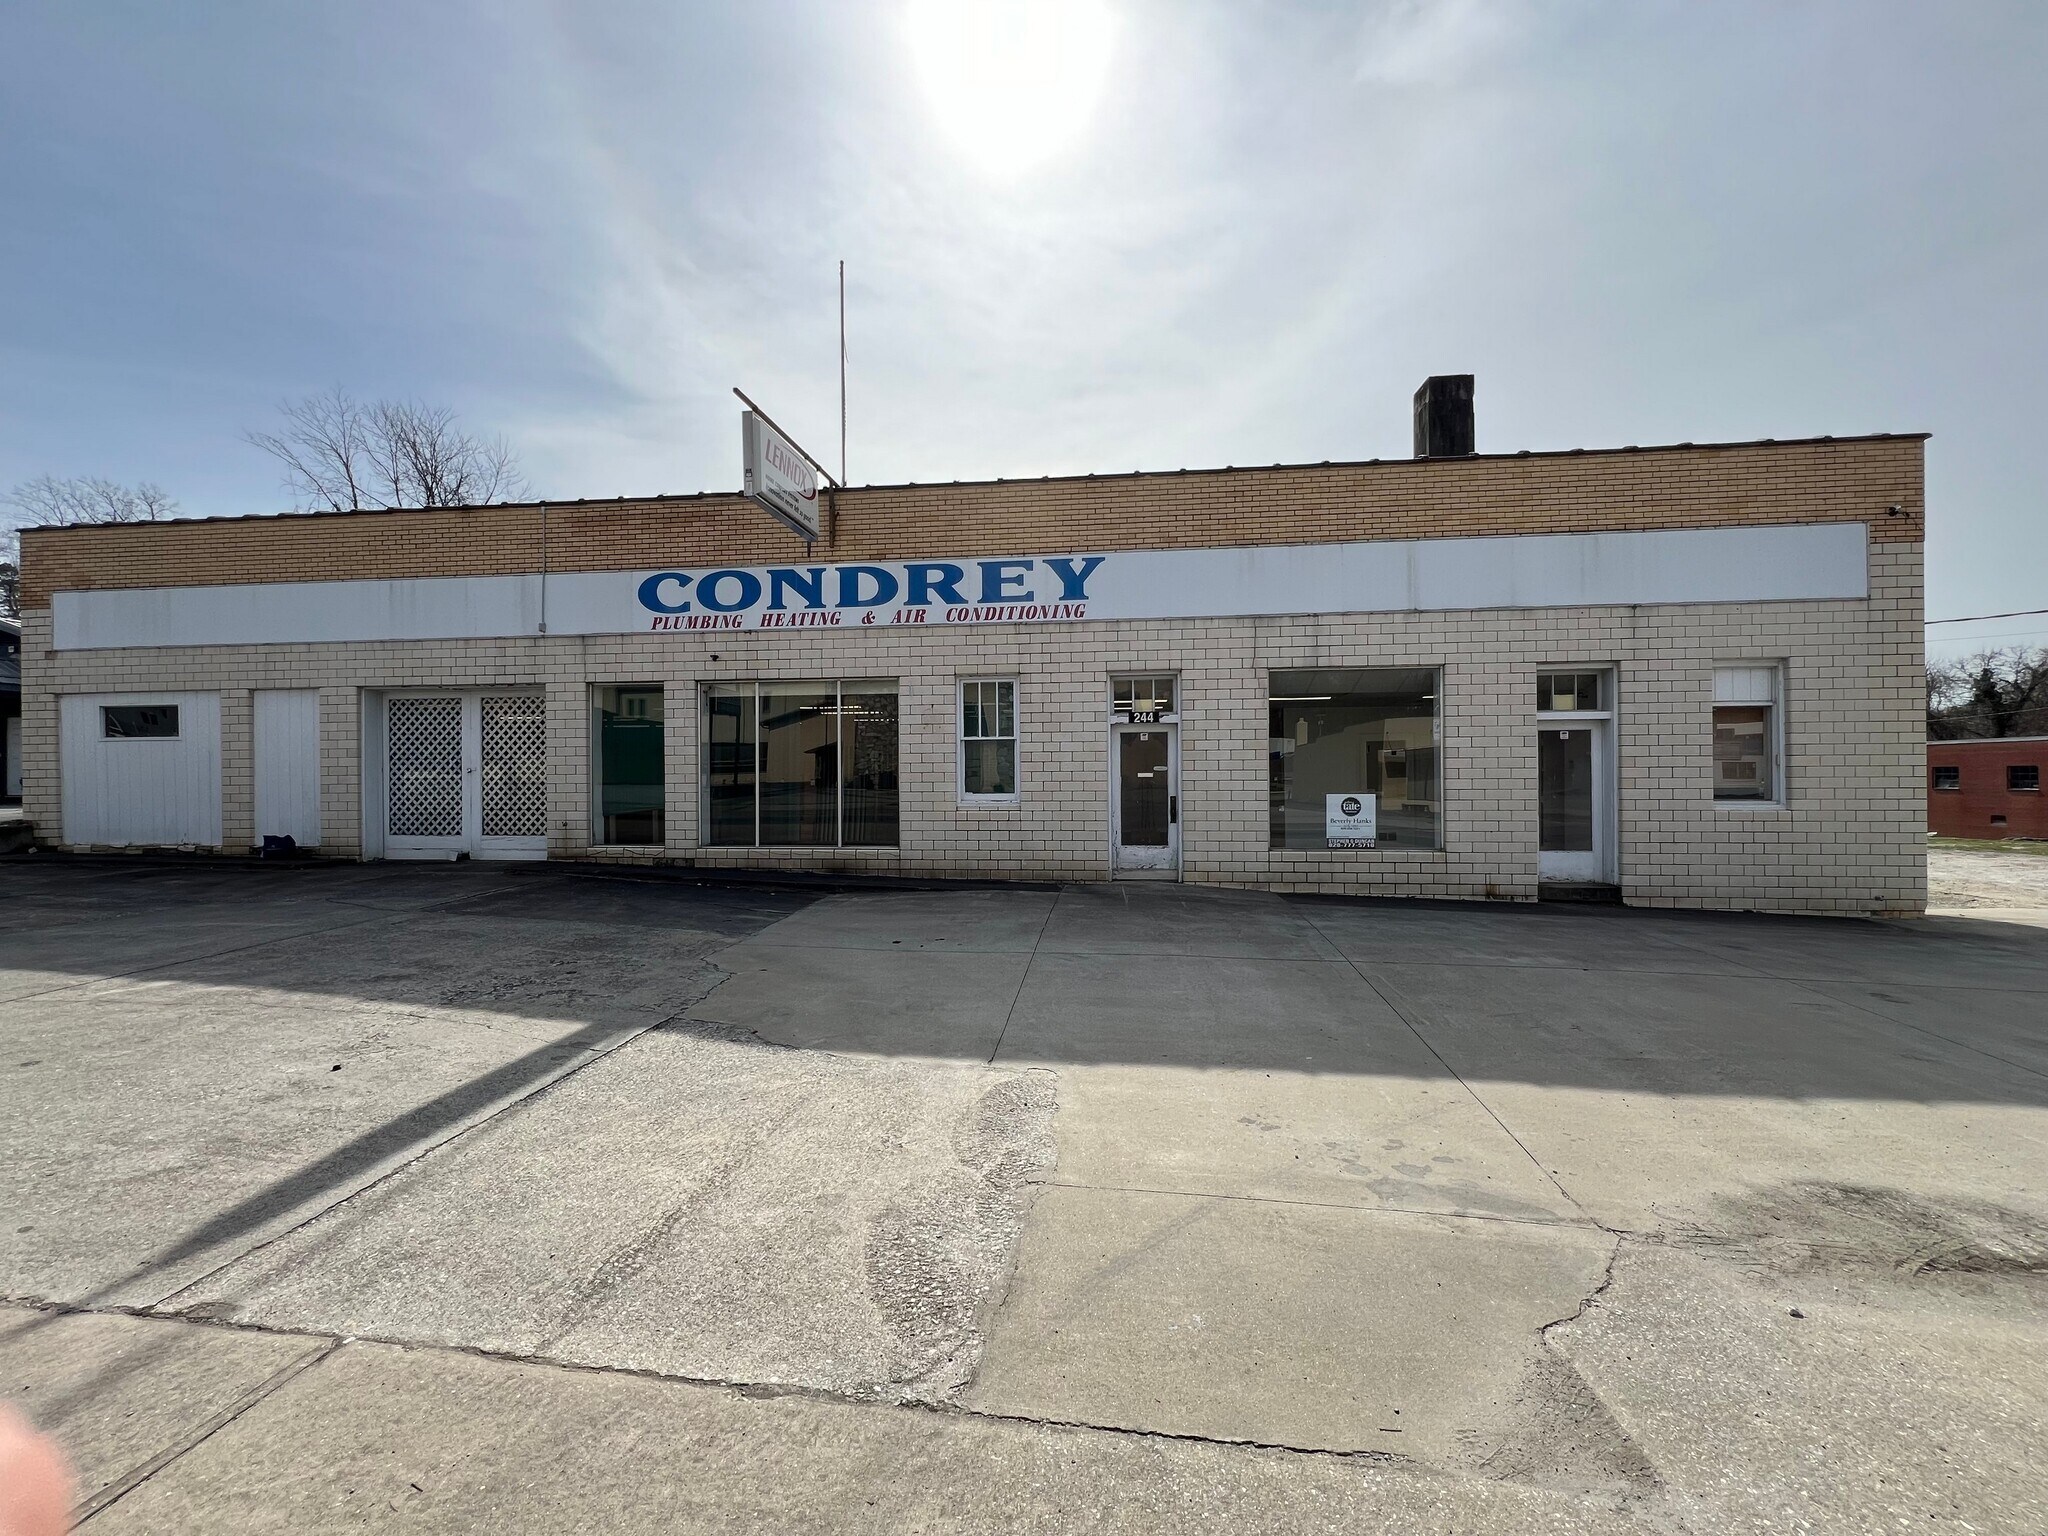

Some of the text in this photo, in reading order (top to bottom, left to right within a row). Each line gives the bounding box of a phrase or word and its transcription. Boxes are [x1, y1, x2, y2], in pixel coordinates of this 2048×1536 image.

[765, 439, 807, 493] LENNOX
[638, 557, 1105, 614] CONDREY
[651, 604, 1086, 630] PLUMBING HEATING & AIR CONDITIONING
[1134, 712, 1154, 723] 244
